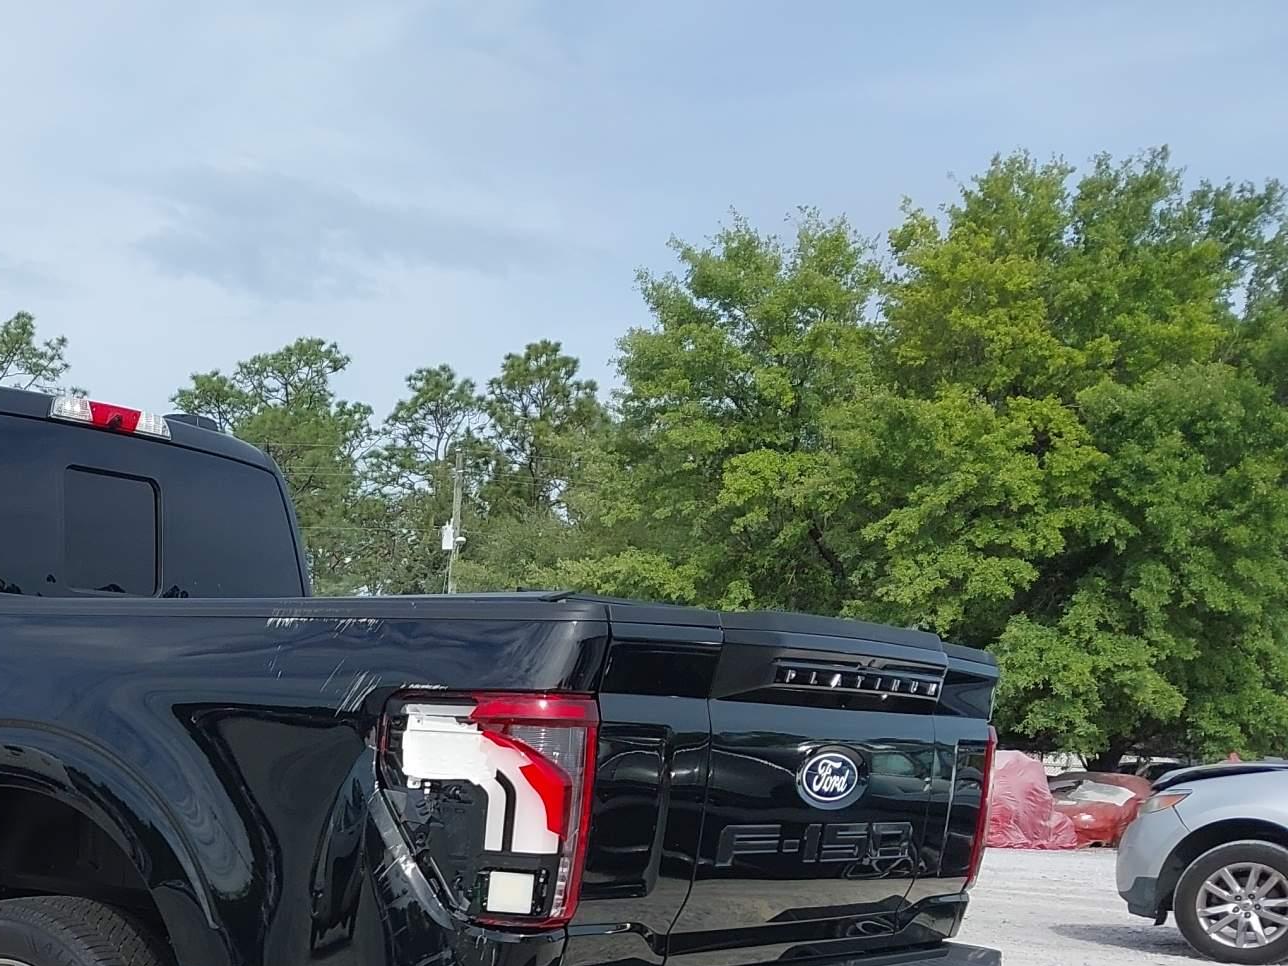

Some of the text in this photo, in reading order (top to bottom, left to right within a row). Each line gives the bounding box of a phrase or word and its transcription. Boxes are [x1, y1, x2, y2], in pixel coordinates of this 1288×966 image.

[784, 669, 938, 696] PLATINUM
[811, 759, 849, 794] Ford
[714, 821, 914, 868] F-150
